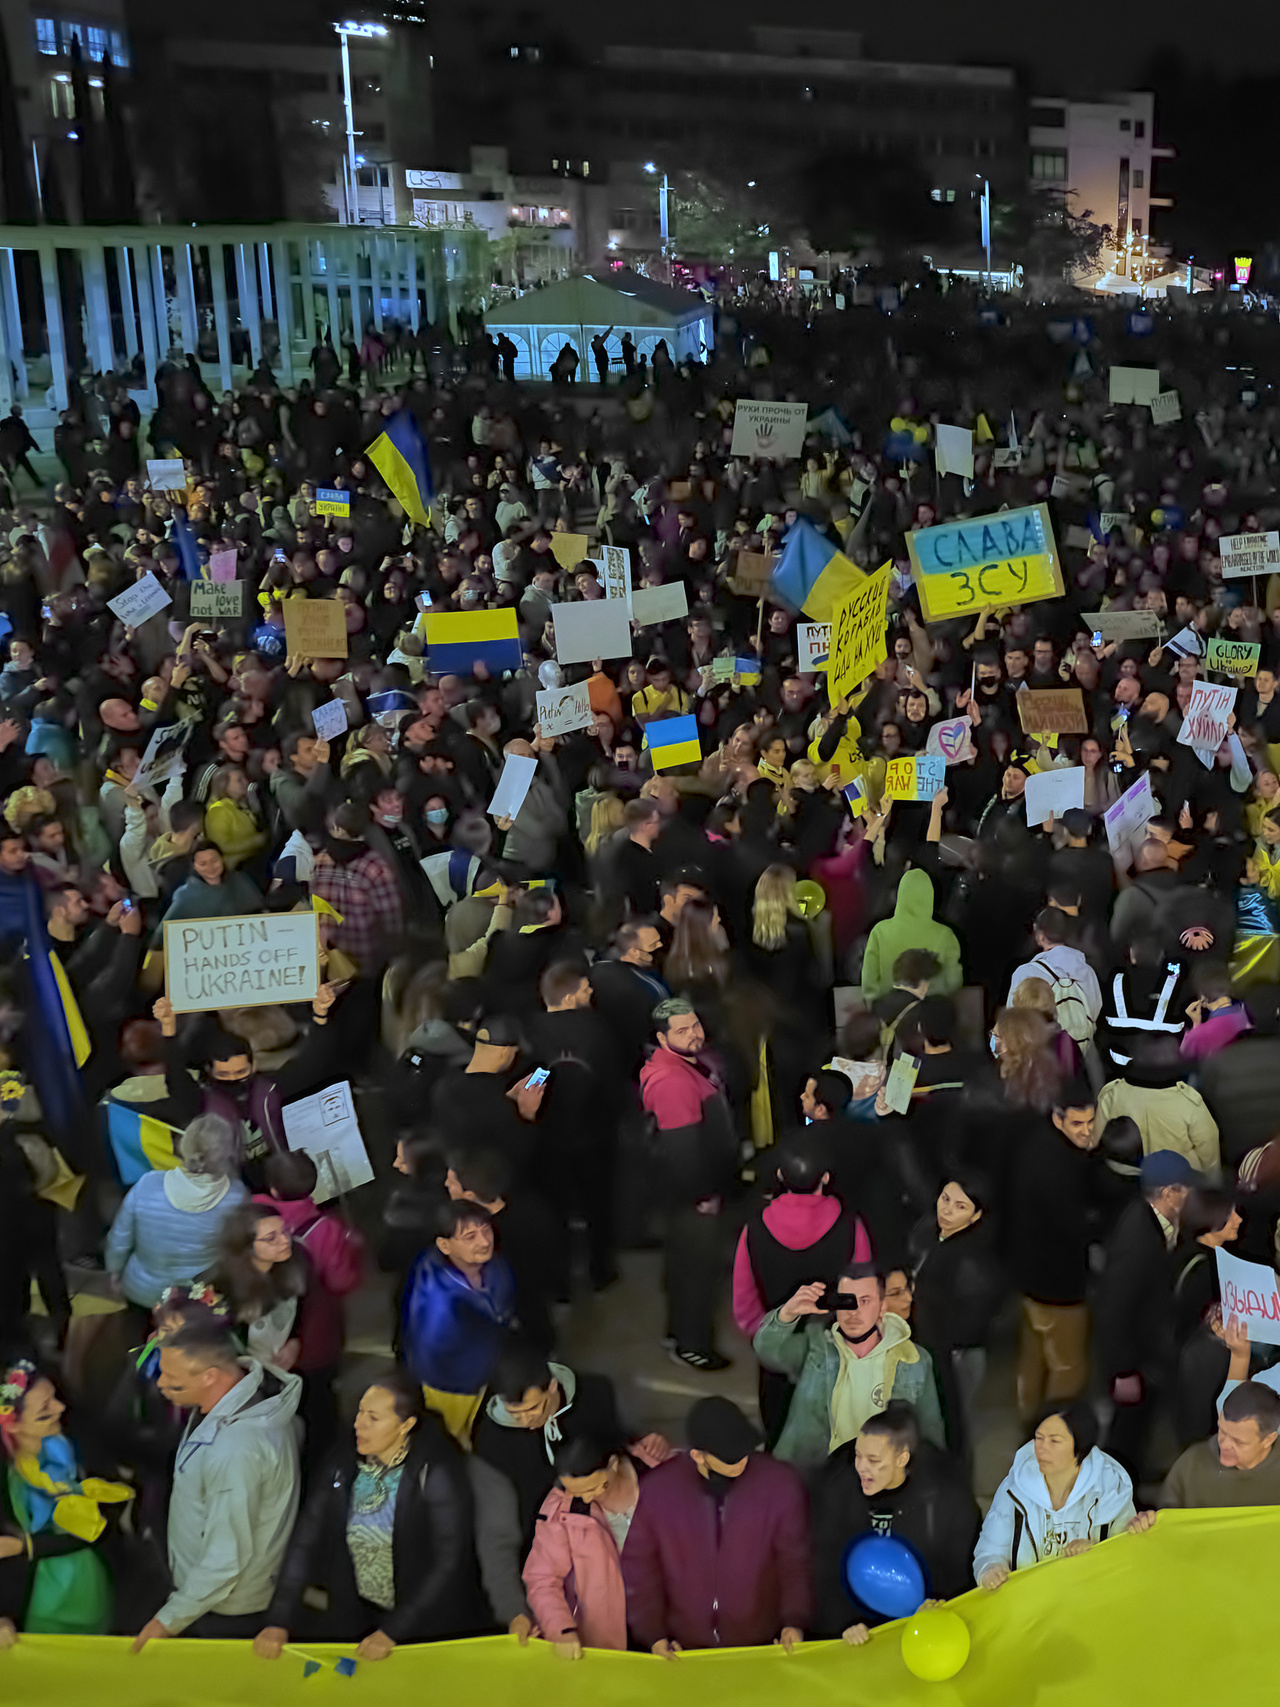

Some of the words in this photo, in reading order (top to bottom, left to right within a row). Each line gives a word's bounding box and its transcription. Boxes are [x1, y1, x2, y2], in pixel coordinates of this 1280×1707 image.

[738, 404, 760, 414] РУКИ
[762, 406, 791, 415] ПРОЧЬ
[794, 408, 806, 416] ОТ
[748, 415, 791, 425] УКРАИНЫ
[933, 515, 1040, 567] СЛАВА
[193, 581, 227, 595] Make
[950, 560, 1028, 606] ЗСУ
[191, 605, 212, 615] not
[218, 606, 240, 615] WAR
[215, 595, 240, 607] love
[1215, 644, 1253, 660] GLORY
[1190, 687, 1232, 711] ПУТІН
[1184, 713, 1225, 741] ХУЙЛО
[182, 920, 269, 953] PUTIN
[184, 951, 251, 974] HANDS
[258, 947, 298, 964] OFF
[184, 965, 306, 1000] UKRAINE!
